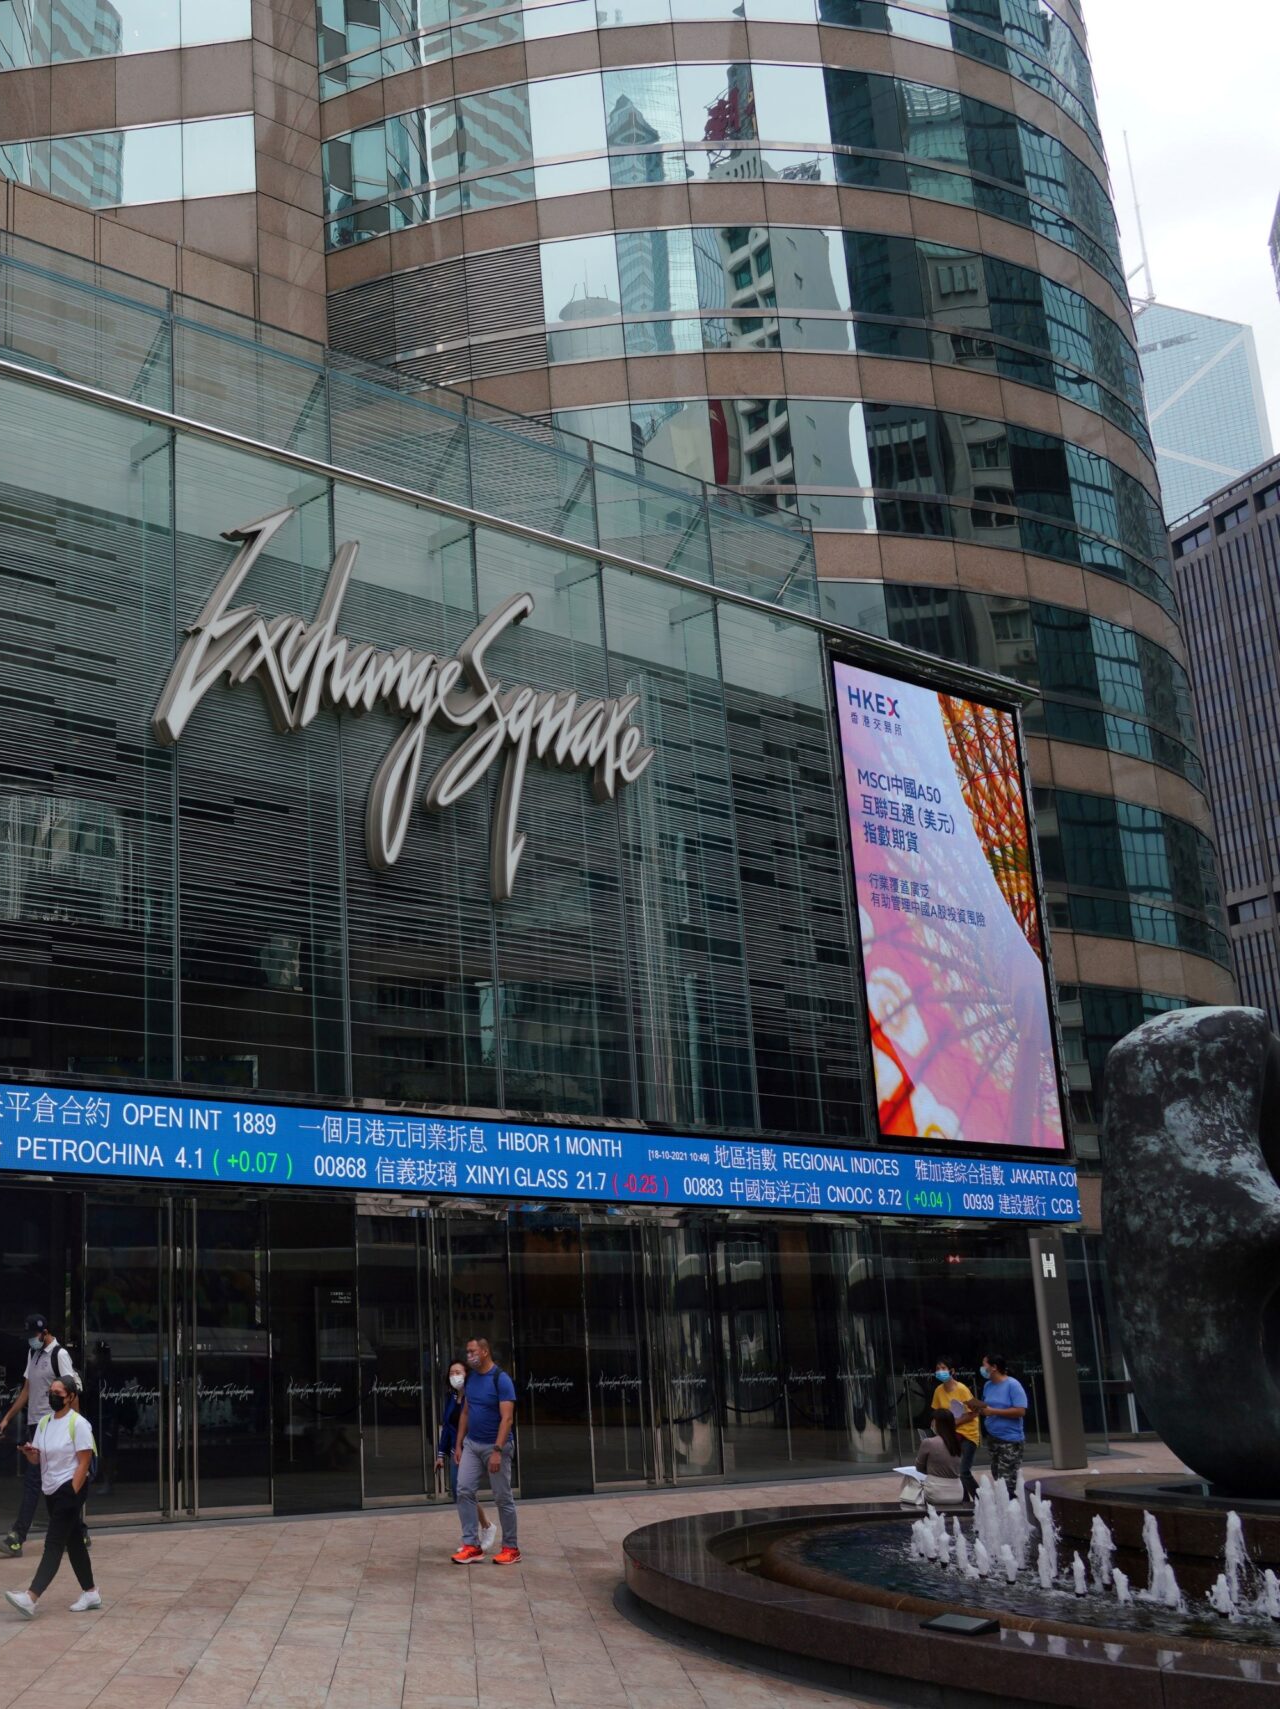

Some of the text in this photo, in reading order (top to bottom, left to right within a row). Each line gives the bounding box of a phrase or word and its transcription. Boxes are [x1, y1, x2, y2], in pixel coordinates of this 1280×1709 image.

[151, 506, 655, 900] Exchange Square
[848, 685, 900, 719] HKEX
[863, 821, 920, 854] 指數期貨
[17, 1136, 164, 1167] PETROCHINA
[175, 1147, 203, 1169] 4.1
[314, 1156, 367, 1178] 00868
[375, 1156, 457, 1187] 信義玻璃
[465, 1165, 510, 1185] XINYI
[514, 1167, 568, 1189] GLASS
[576, 1171, 606, 1190] 21.7
[683, 1177, 724, 1197] 00883
[730, 1177, 821, 1205] 中國海洋石油
[827, 1186, 873, 1204] CNOOC
[878, 1189, 902, 1206] 8.72
[963, 1193, 994, 1210] 00939
[997, 1193, 1046, 1216] 建設銀行
[1051, 1198, 1074, 1214] CCB
[123, 1103, 183, 1128] OPEN
[190, 1108, 222, 1131] INT
[233, 1111, 276, 1135] 1889
[299, 1115, 487, 1153] 一個月港元同業拆息
[498, 1131, 549, 1153] HIBOR
[554, 1136, 561, 1153] 1
[566, 1137, 622, 1158] MONTH
[714, 1145, 778, 1171] 地區指數
[783, 1152, 845, 1172] REGIONAL
[851, 1157, 899, 1175] INDICES
[1010, 1168, 1058, 1186] JAKARTA
